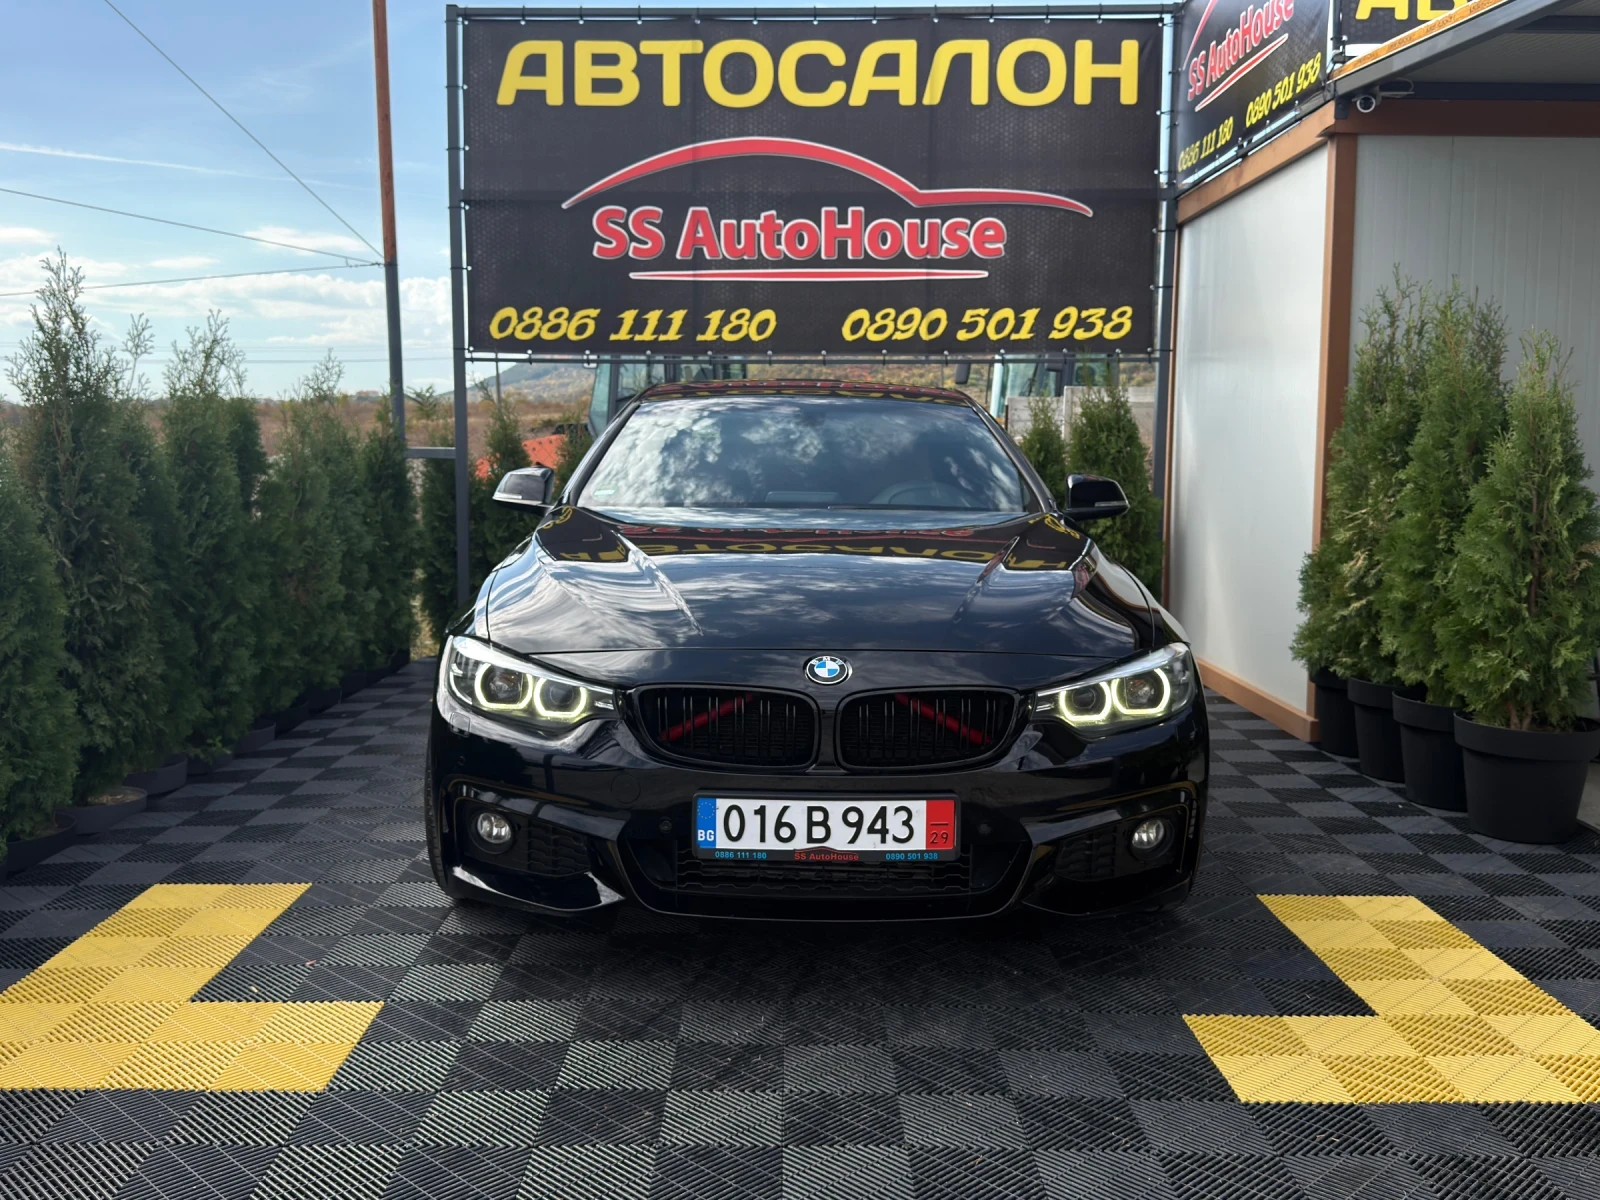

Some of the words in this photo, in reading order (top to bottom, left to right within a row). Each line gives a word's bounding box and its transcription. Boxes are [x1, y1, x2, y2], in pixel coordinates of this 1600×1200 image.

[1188, 50, 1206, 101] SS
[1206, 0, 1294, 88] AutoHouse
[496, 38, 1139, 107] АВТОСАЛОН
[1246, 88, 1272, 128] 0890
[1272, 72, 1296, 110] 501
[1296, 52, 1321, 93] 938
[1200, 128, 1217, 159] 111
[1216, 116, 1233, 148] 180
[592, 205, 665, 260] SS
[676, 206, 1007, 260] AutoHouse
[489, 306, 601, 341] 0886
[609, 308, 688, 341] 111
[696, 308, 778, 342] 180
[841, 307, 948, 341] 0890
[956, 307, 1040, 341] 501
[1048, 306, 1133, 340] 938
[697, 829, 715, 842] BG
[930, 831, 949, 845] 29
[715, 851, 735, 859] 0886
[737, 851, 750, 859] 111
[794, 853, 807, 861] SS
[809, 852, 859, 861] AutoHouse
[923, 852, 938, 860] 938
